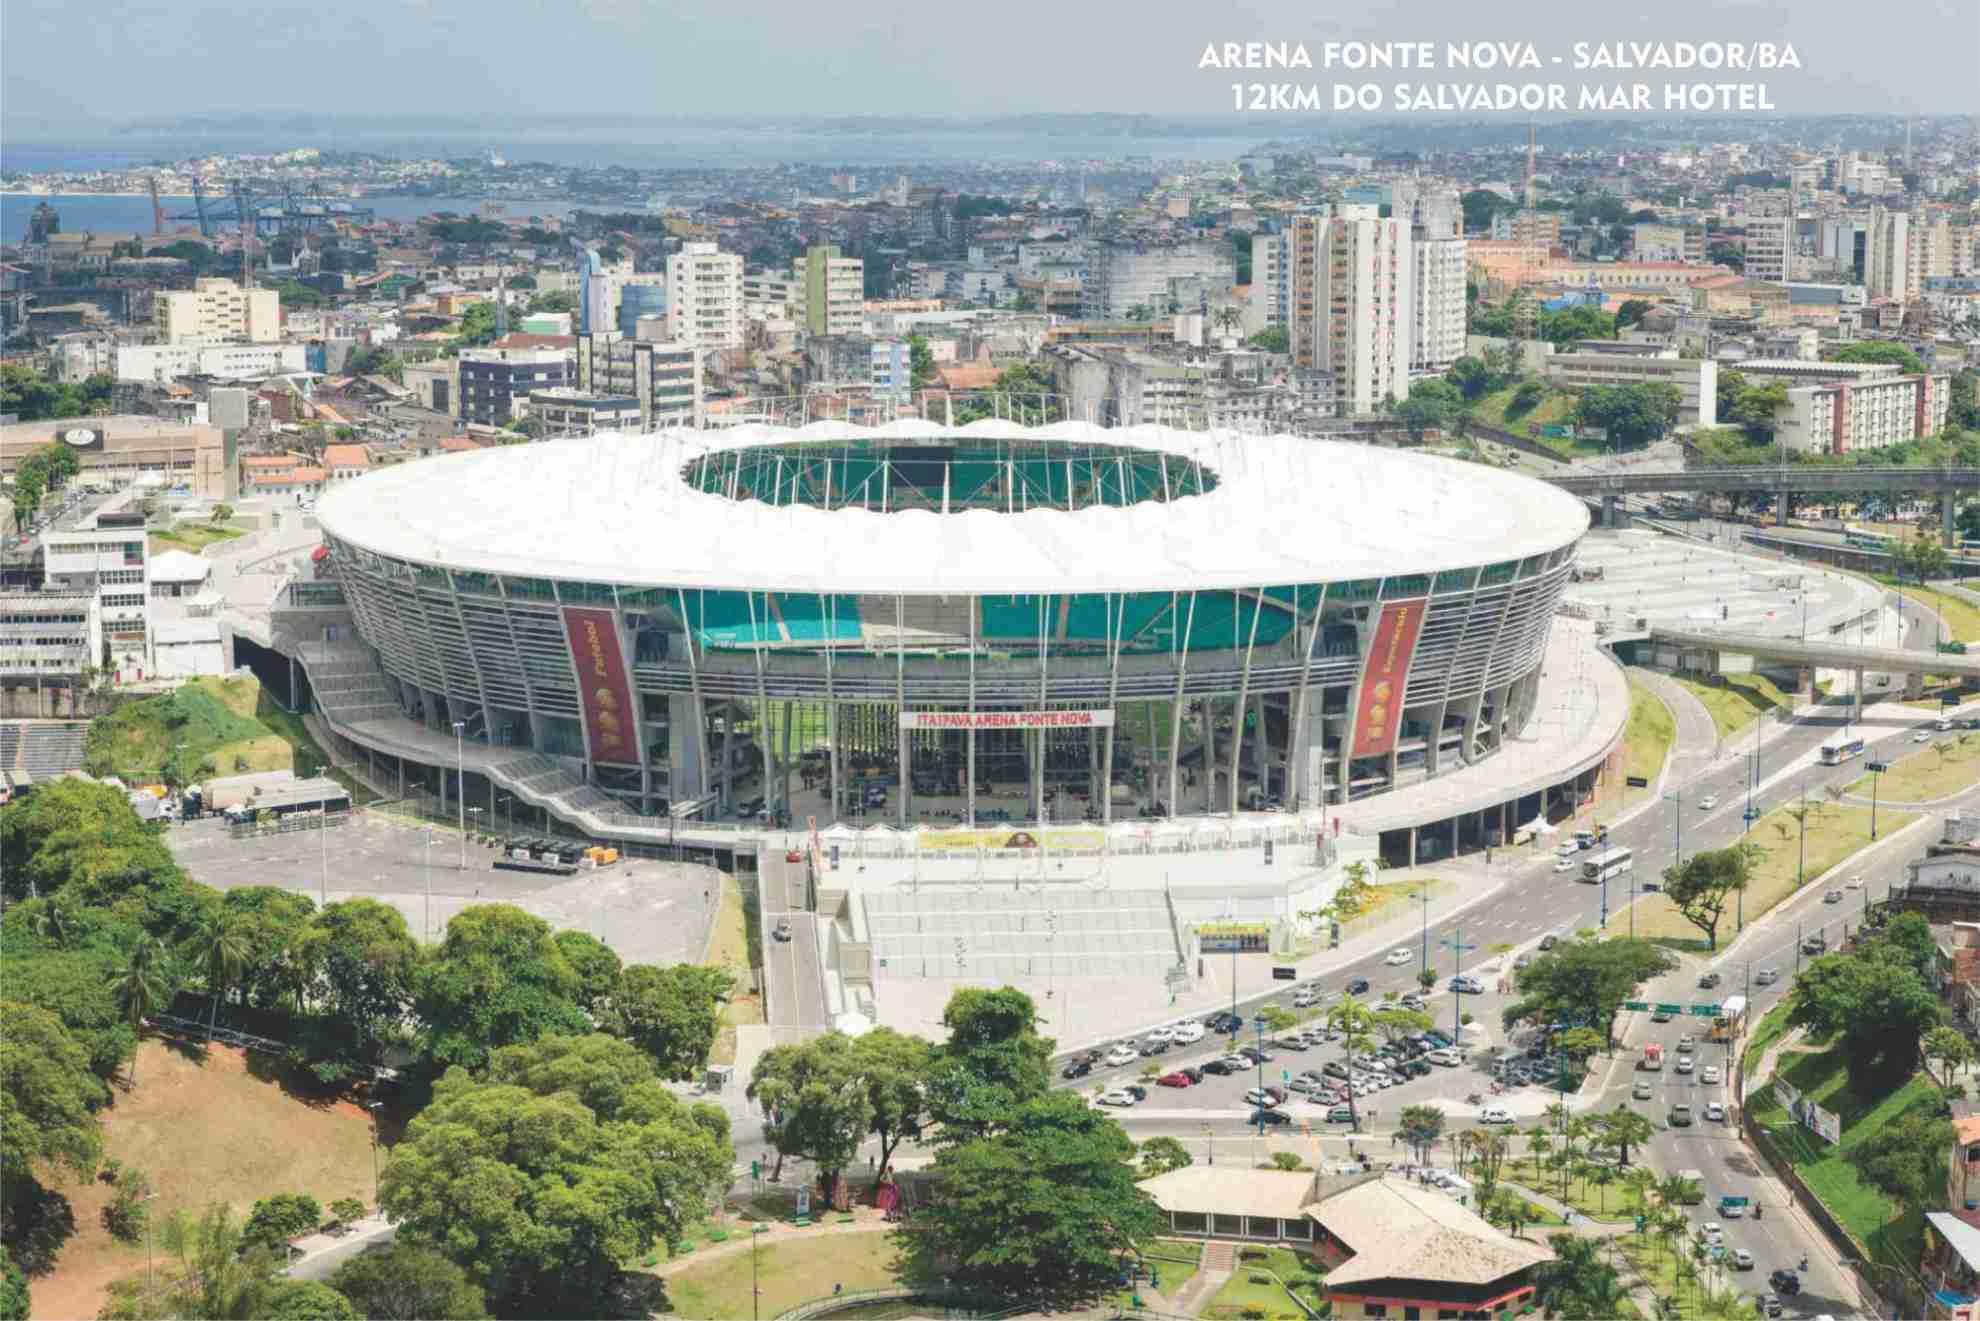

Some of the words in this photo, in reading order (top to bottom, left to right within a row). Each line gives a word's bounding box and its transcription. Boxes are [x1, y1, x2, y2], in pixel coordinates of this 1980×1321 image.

[975, 714, 1017, 726] ARENA
[1020, 713, 1058, 726] FONTE
[1060, 712, 1092, 725] NOVA
